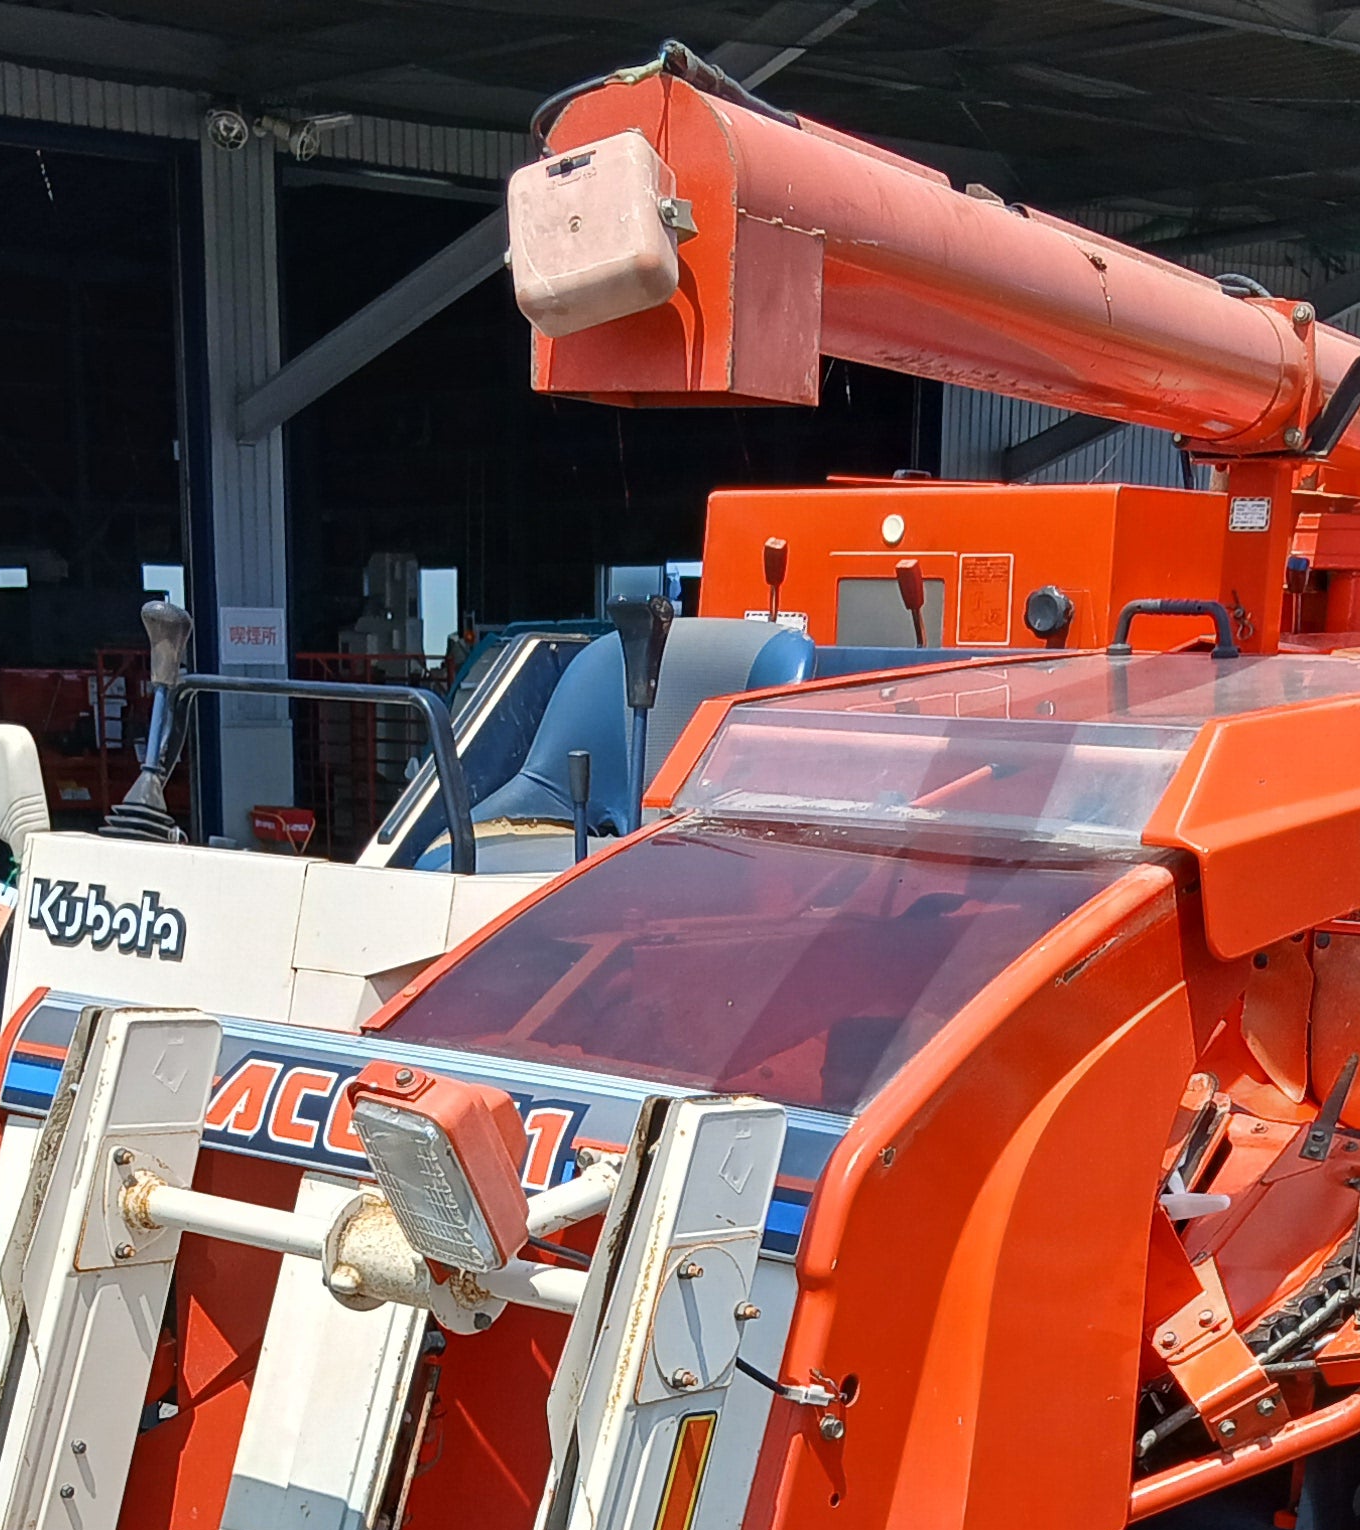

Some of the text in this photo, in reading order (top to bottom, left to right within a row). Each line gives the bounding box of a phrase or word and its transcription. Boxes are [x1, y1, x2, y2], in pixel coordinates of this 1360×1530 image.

[229, 625, 277, 646] 喫煙所
[29, 879, 186, 960] Kubota
